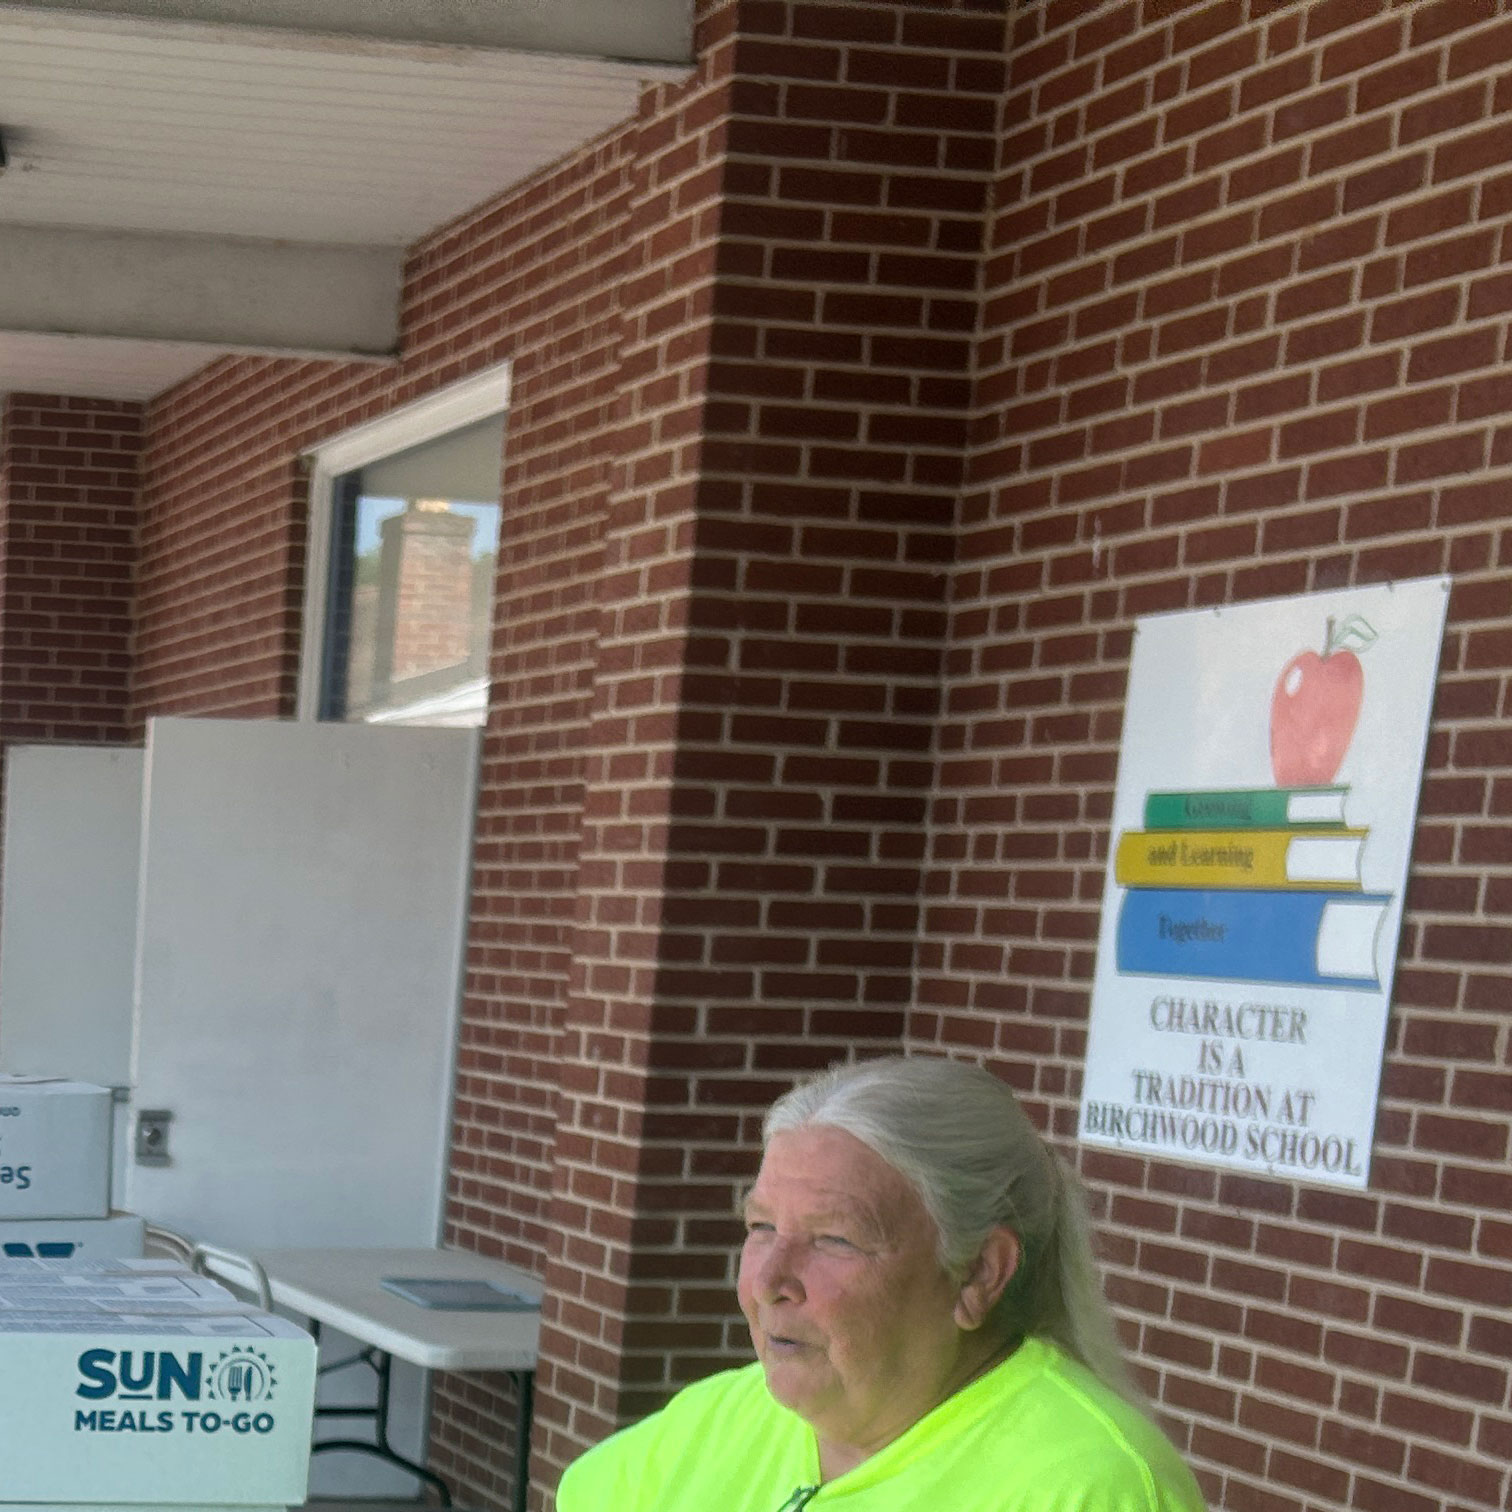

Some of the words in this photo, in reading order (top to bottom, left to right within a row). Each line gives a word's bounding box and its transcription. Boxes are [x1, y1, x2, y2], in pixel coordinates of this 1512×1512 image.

[1180, 841, 1254, 873] Learning
[1150, 995, 1308, 1044] CHARACTER
[1197, 1039, 1222, 1075] IS
[1228, 1042, 1246, 1078] A
[1132, 1068, 1272, 1119] TRADITION
[1277, 1089, 1316, 1127] AT
[1087, 1102, 1238, 1155] BIRCHWOOD
[1244, 1123, 1361, 1177] SCHOOL
[75, 1347, 203, 1399] SUN
[74, 1410, 174, 1433] MEALS
[182, 1409, 275, 1434] TO-GO
